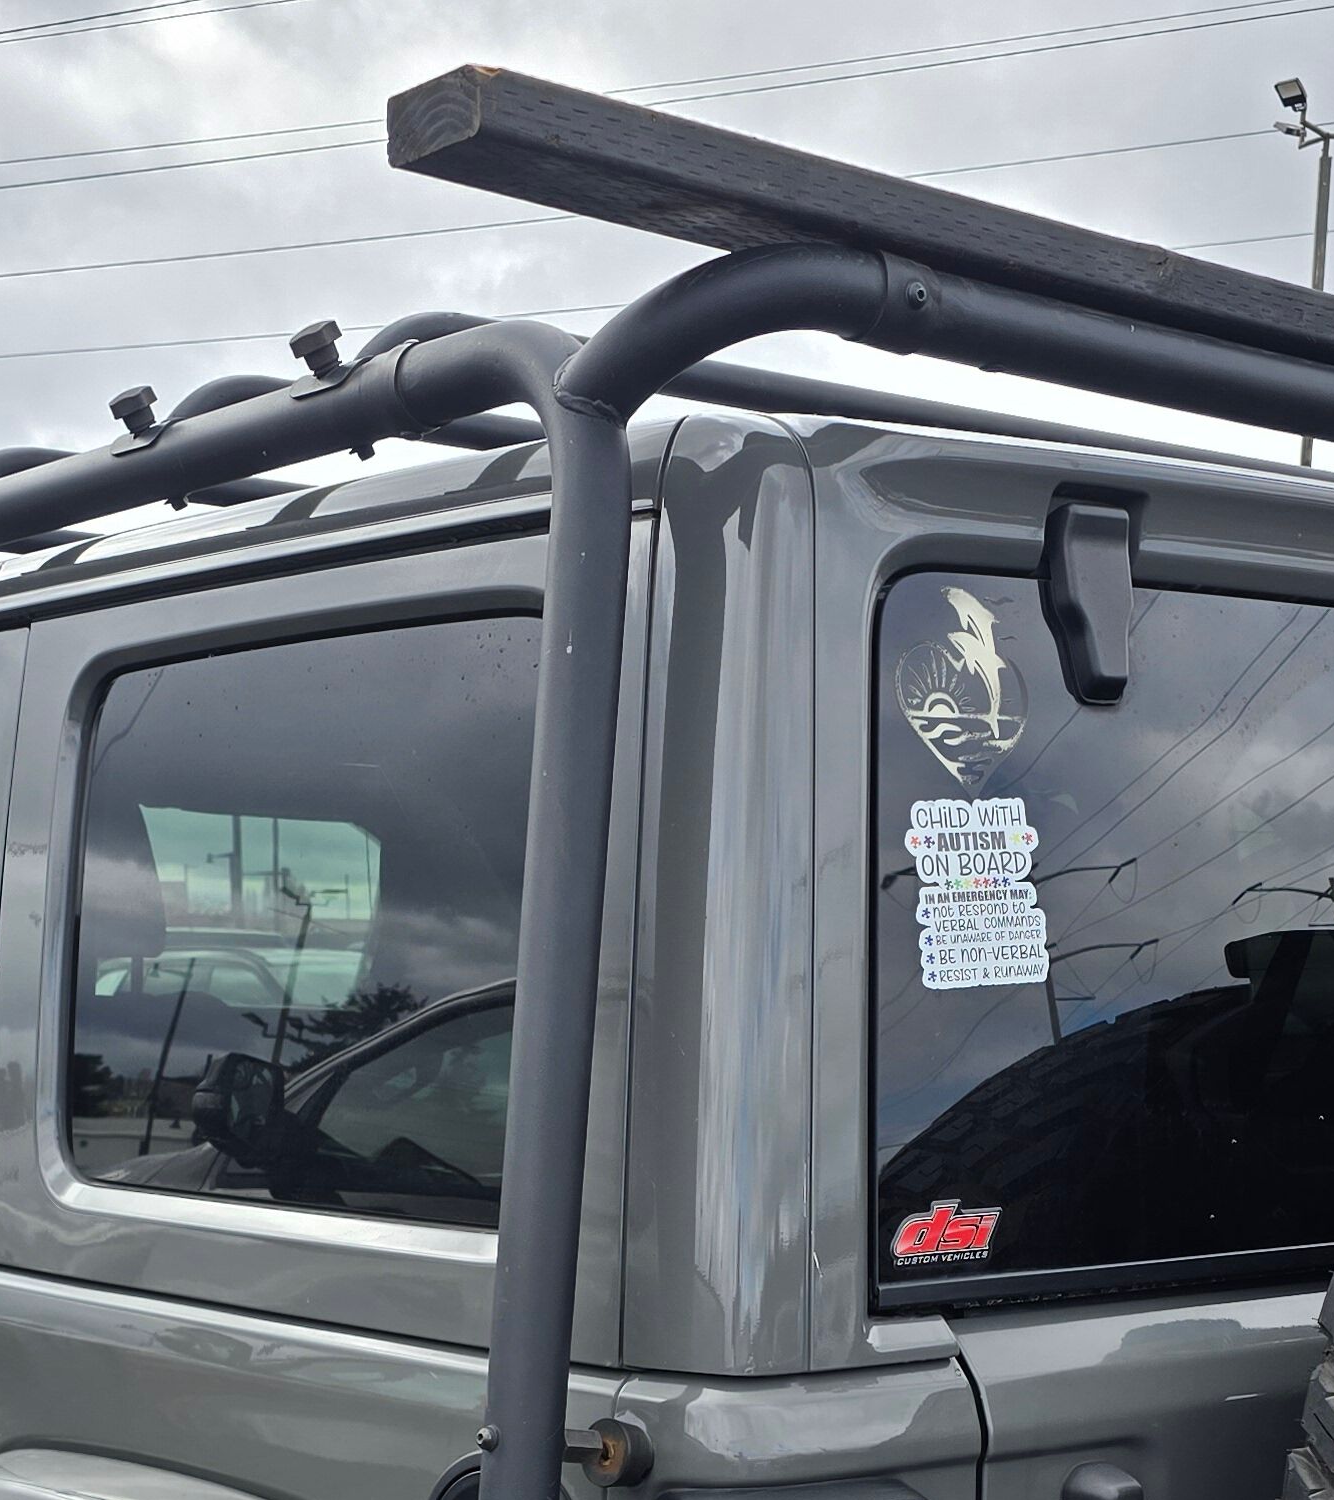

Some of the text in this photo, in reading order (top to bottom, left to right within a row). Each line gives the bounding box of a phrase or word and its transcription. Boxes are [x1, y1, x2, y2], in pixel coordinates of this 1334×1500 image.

[937, 831, 1007, 852] AUTISM
[921, 851, 1027, 877] ON BOARD
[924, 889, 1032, 905] IN AN EMERGENCY MAY:
[934, 918, 979, 933] VERBAL
[936, 934, 948, 946] BE
[994, 931, 1006, 941] OF
[939, 949, 957, 965] BE
[939, 968, 978, 982] RESIST
[982, 967, 990, 979] &
[894, 1204, 1000, 1257] dsi
[897, 1250, 989, 1266] CUSTOM VEHICLES
